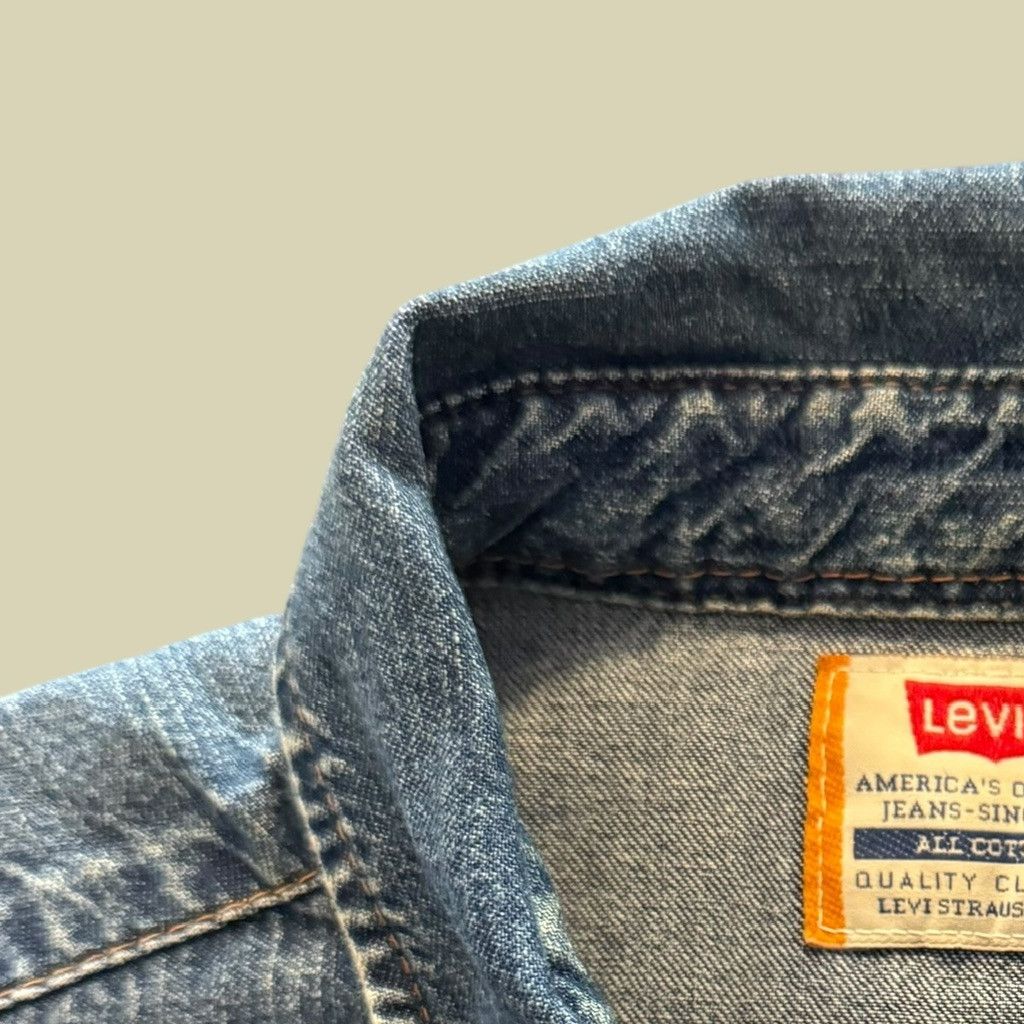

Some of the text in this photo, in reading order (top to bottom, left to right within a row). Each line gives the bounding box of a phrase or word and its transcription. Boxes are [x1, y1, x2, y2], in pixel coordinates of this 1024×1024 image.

[855, 774, 1000, 795] AMERICA'S
[915, 836, 963, 853] ALL
[856, 871, 976, 891] QUALITY
[878, 898, 931, 915] LEVI
